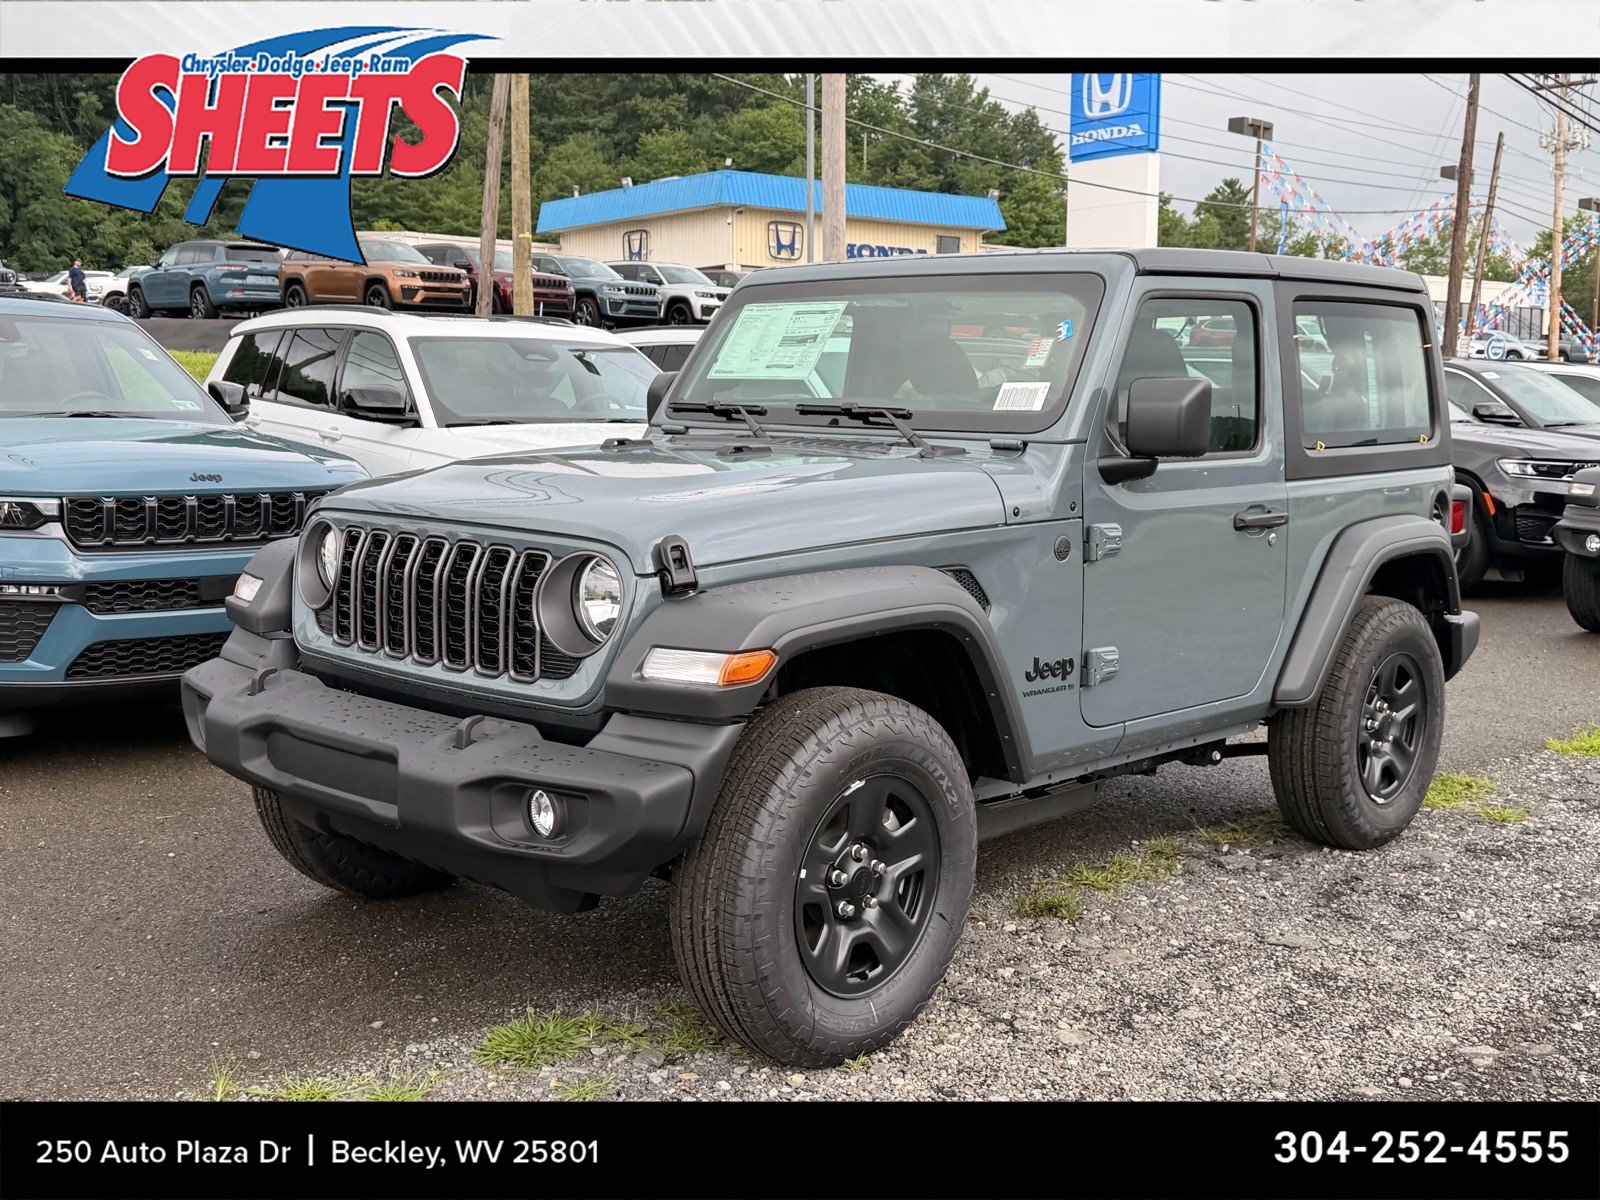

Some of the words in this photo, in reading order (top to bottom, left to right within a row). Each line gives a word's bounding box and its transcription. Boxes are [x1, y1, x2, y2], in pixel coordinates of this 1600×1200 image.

[1071, 123, 1145, 146] HONDA
[189, 472, 223, 483] Jeep
[1025, 656, 1074, 682] Jeep
[1022, 684, 1067, 697] WRANGLER
